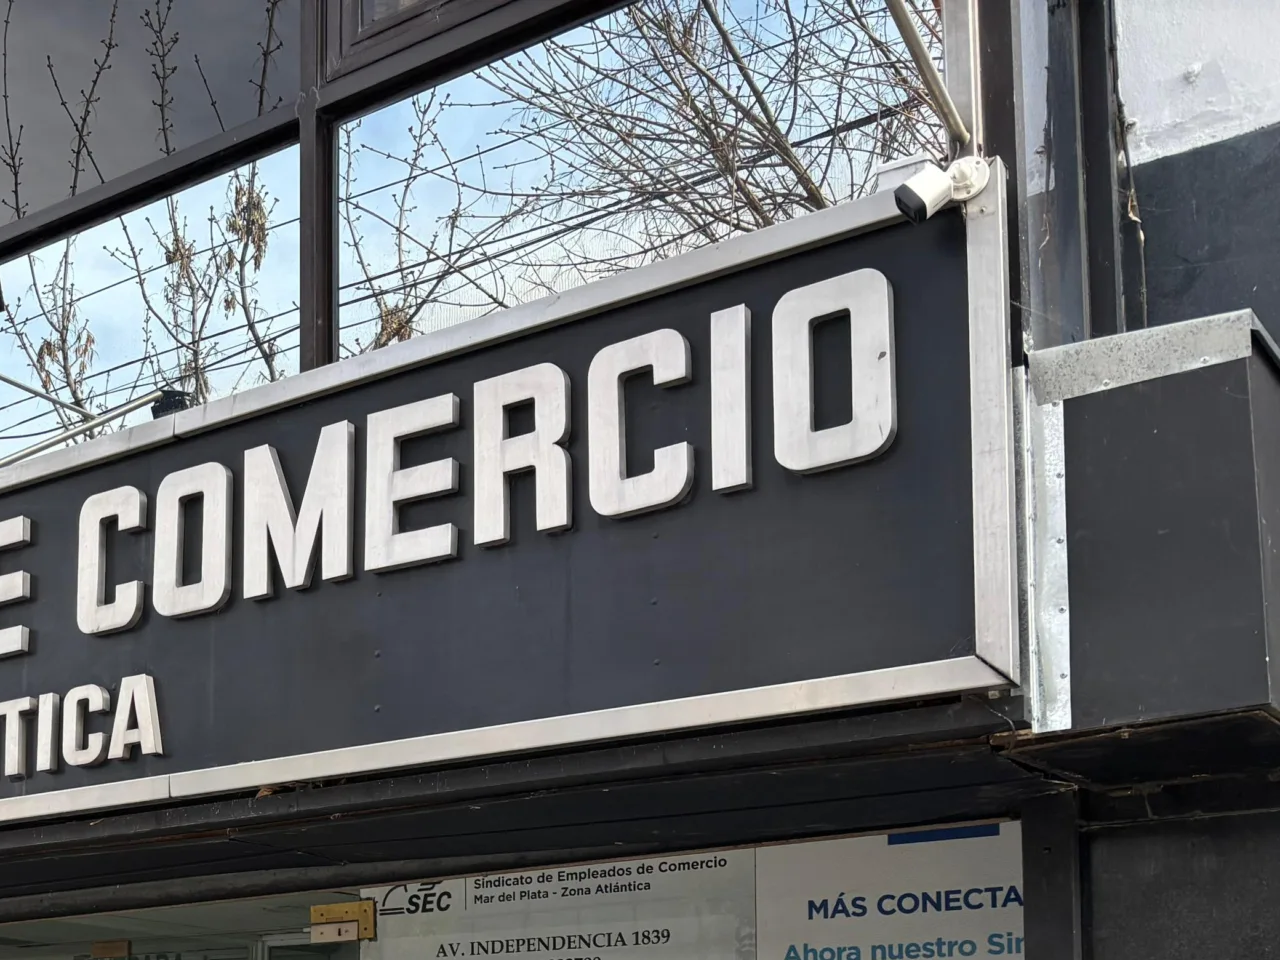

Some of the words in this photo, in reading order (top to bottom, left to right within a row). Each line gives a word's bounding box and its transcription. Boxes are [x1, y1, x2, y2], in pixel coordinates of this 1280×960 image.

[76, 267, 896, 636] COMERCIO
[474, 875, 533, 889] Sindicato
[537, 873, 552, 884] de
[558, 866, 632, 883] Empleados
[637, 863, 653, 874] de
[658, 856, 727, 873] Comercio
[406, 891, 451, 914] SEC
[808, 892, 867, 920] MÁS
[877, 885, 1024, 915] CONECTA
[436, 943, 464, 958] AV.
[469, 932, 626, 956] INDEPENDENCIA
[631, 928, 670, 945] 1839
[871, 937, 976, 960] nuestro
